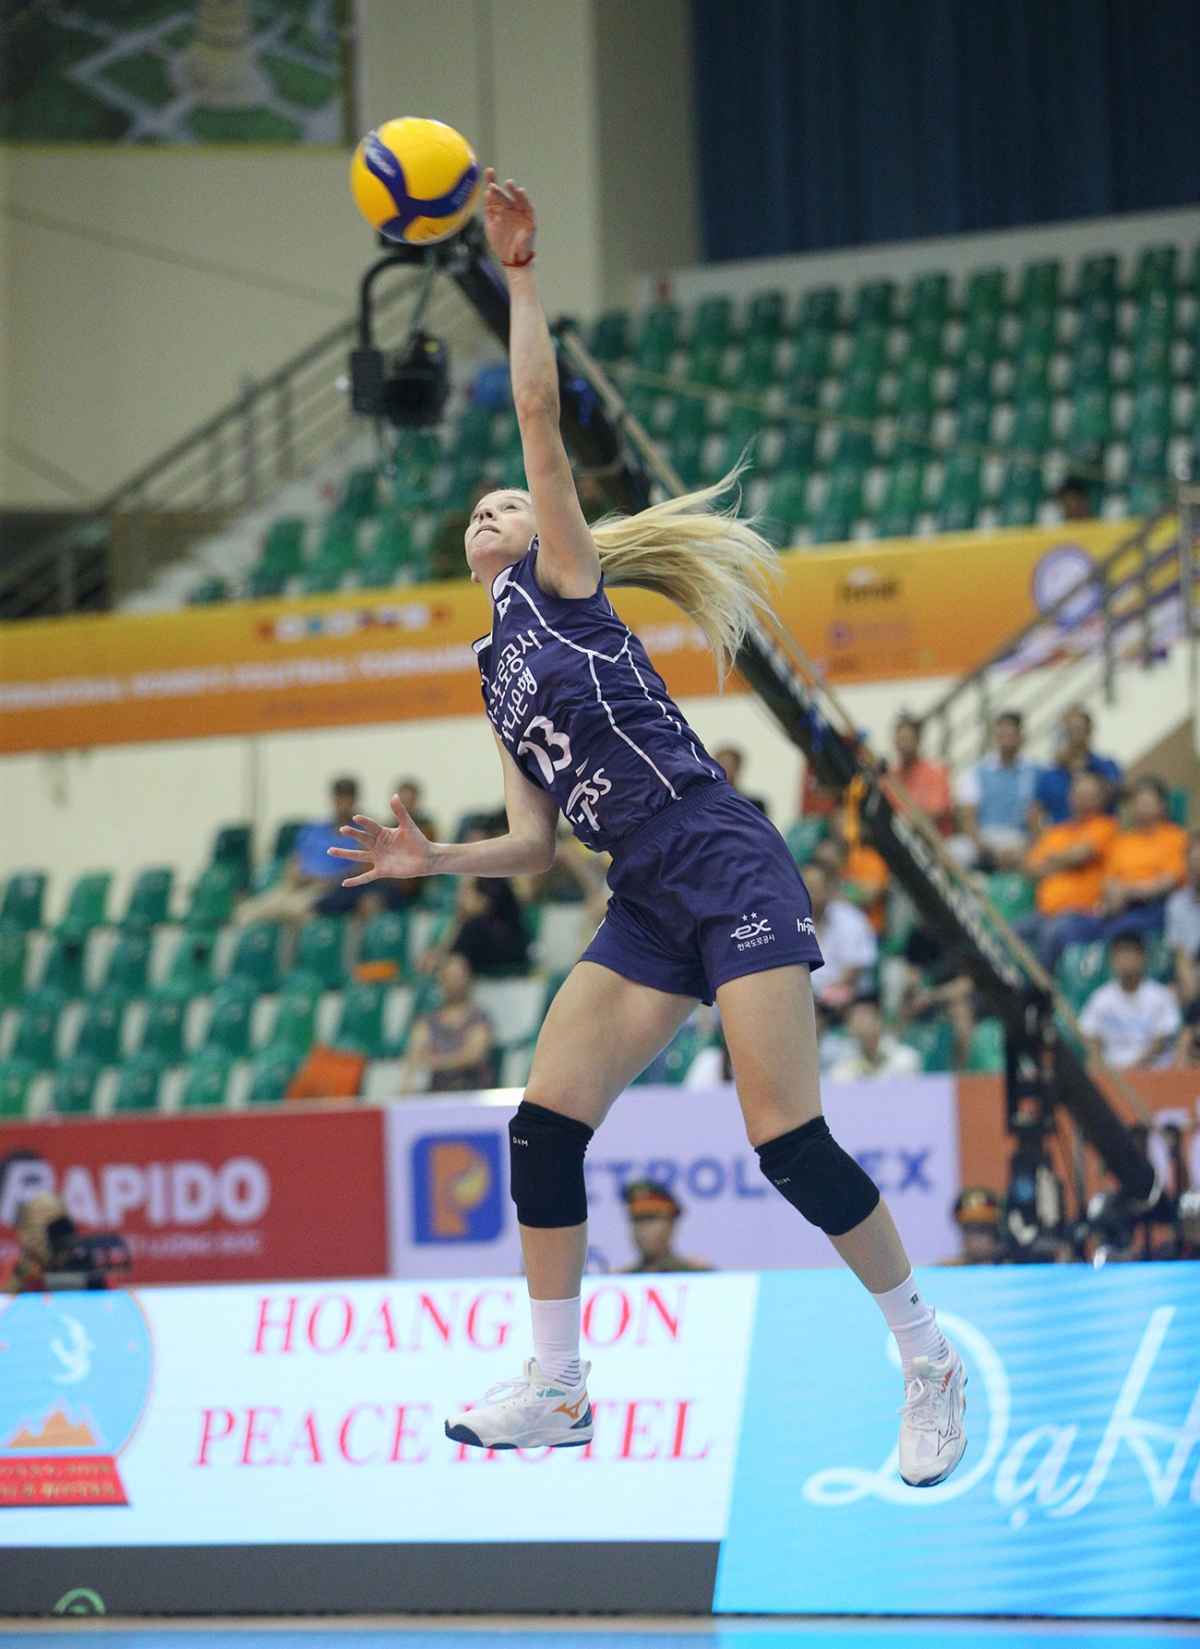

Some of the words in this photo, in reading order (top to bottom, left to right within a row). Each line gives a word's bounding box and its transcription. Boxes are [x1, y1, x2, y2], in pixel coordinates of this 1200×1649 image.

[517, 715, 572, 785] 13
[730, 918, 771, 940] ex
[0, 1155, 271, 1228] RAPIDO
[249, 1288, 518, 1354] HOANG
[580, 1282, 690, 1347] ON
[191, 1402, 431, 1468] PEACE
